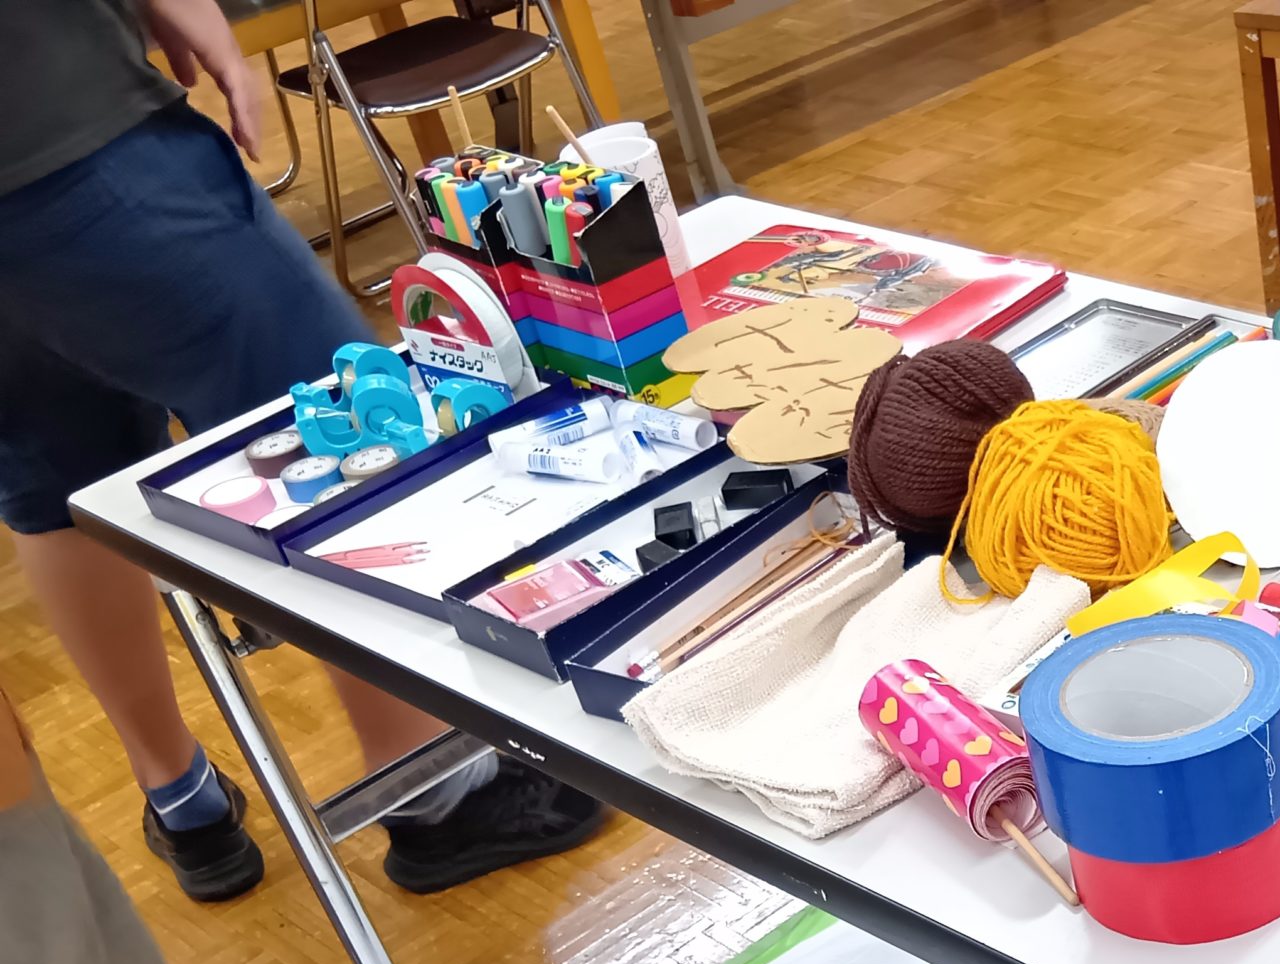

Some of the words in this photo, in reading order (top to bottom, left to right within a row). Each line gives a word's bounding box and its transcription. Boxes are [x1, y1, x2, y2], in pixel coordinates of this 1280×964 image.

[429, 351, 484, 373] ナイスタック
